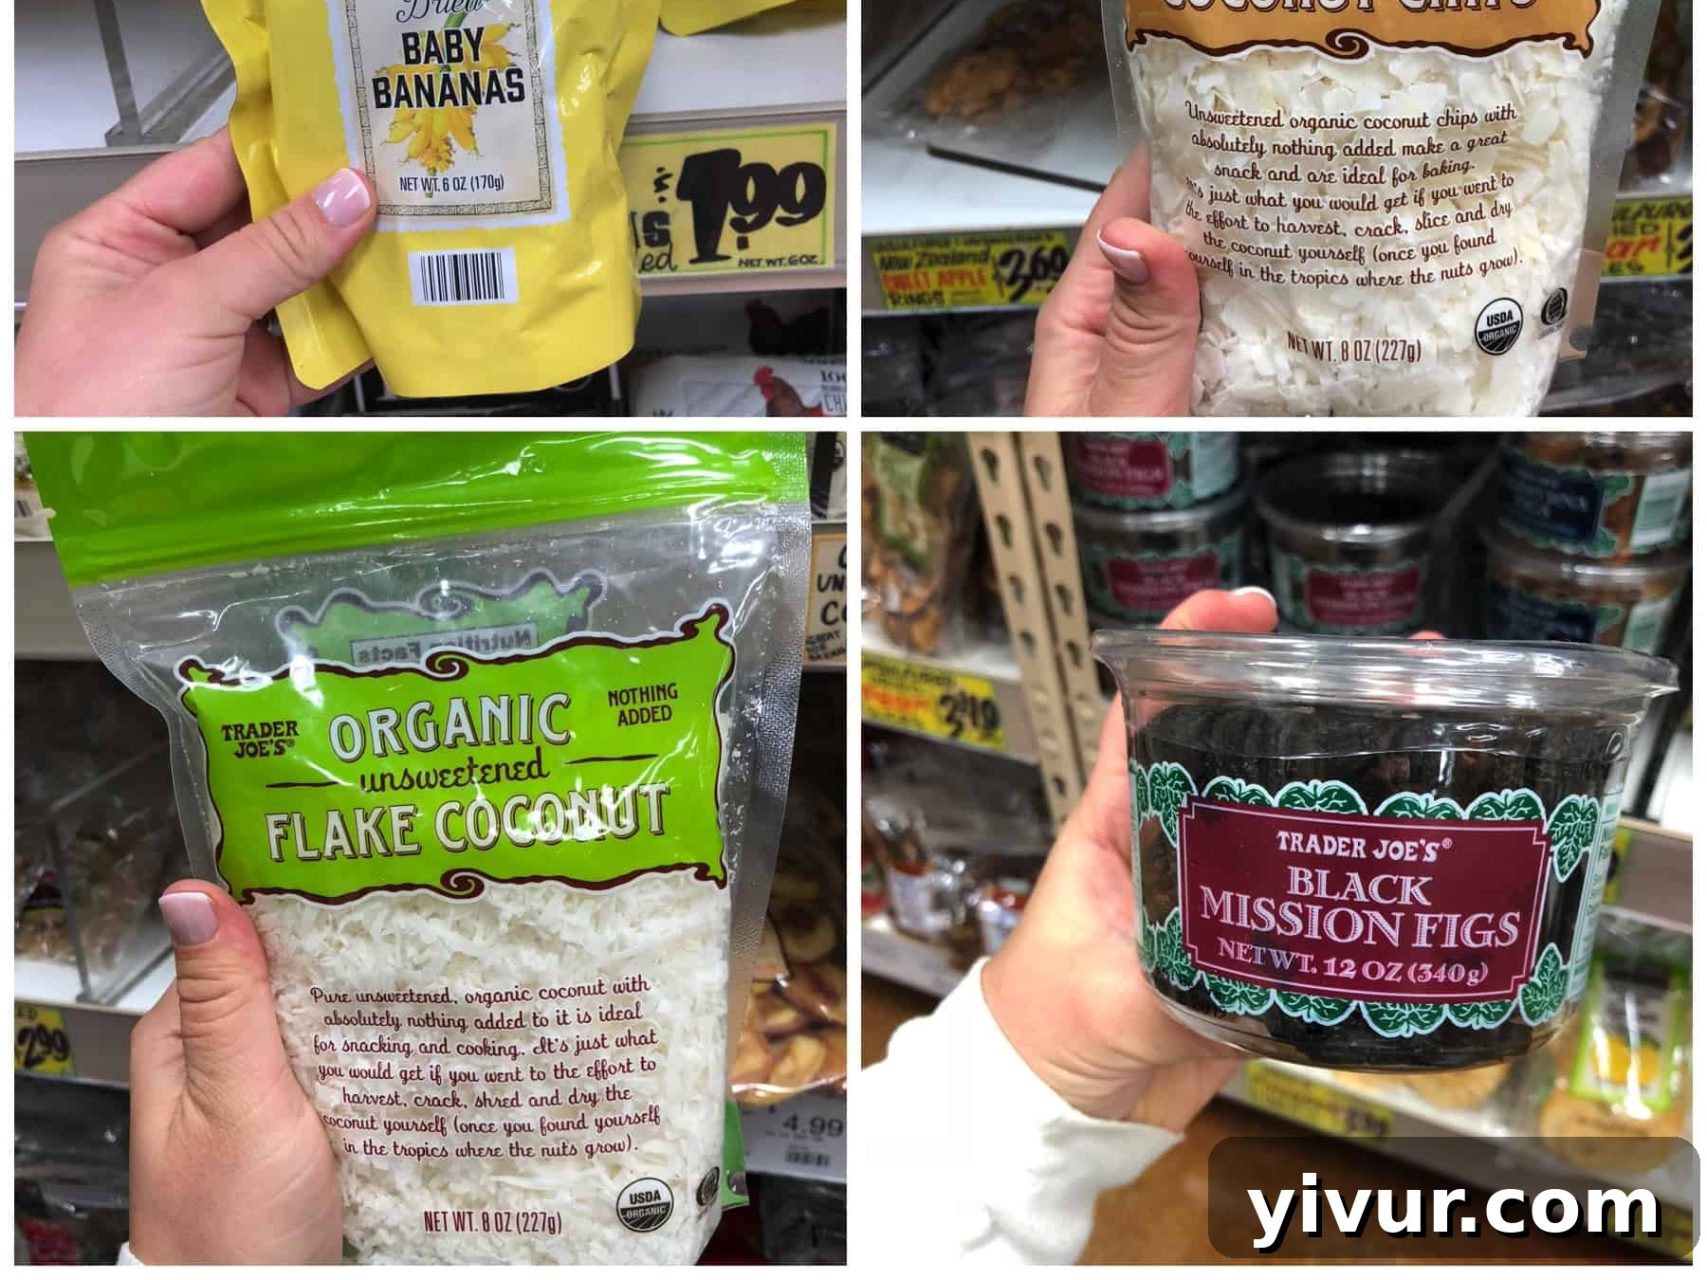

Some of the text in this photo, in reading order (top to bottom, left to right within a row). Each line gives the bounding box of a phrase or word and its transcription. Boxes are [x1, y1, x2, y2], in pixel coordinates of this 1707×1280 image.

[402, 27, 485, 65] BABY
[372, 68, 526, 109] BANANAS
[1185, 100, 1517, 134] Unsweetened organic coconut chips with
[1192, 129, 1509, 161] absolutely nothing added make a great
[400, 176, 418, 192] NET
[443, 177, 450, 191] 6
[453, 176, 467, 191] OZ
[471, 174, 505, 192] (170g)
[1483, 325, 1518, 342] ORGANIC
[1486, 311, 1514, 327] USDA
[1288, 331, 1309, 354] NET
[1341, 342, 1349, 361] 8
[1354, 341, 1371, 362] OZ
[1376, 340, 1422, 363] (227g)
[608, 683, 678, 707] NOTHING
[222, 720, 300, 742] TRADER
[328, 693, 571, 763] ORGANIC
[617, 705, 672, 727] ADDED
[360, 746, 550, 793] unsweetened
[265, 783, 670, 863] FLAKE COCONUT
[1277, 831, 1367, 859] TRADER
[1287, 866, 1432, 906] BLACK
[1201, 886, 1521, 949] MISSION FIGS
[1217, 937, 1268, 966] NET
[1324, 959, 1356, 978] 12
[1361, 960, 1402, 982] OZ
[1408, 962, 1489, 986] (340g)
[310, 974, 651, 1008] Pure unsweetened, organic coconut with
[314, 1035, 337, 1055] for
[342, 1035, 414, 1058] snacking
[419, 1037, 451, 1054] and
[457, 1038, 525, 1061] cooking.
[574, 1033, 610, 1056] just
[616, 1029, 659, 1048] what
[624, 1207, 666, 1219] ORGANIC
[629, 1190, 662, 1205] USDA
[424, 1211, 449, 1232] NET
[482, 1211, 490, 1232] 8
[495, 1211, 512, 1232] OZ
[516, 1211, 562, 1235] (227g)
